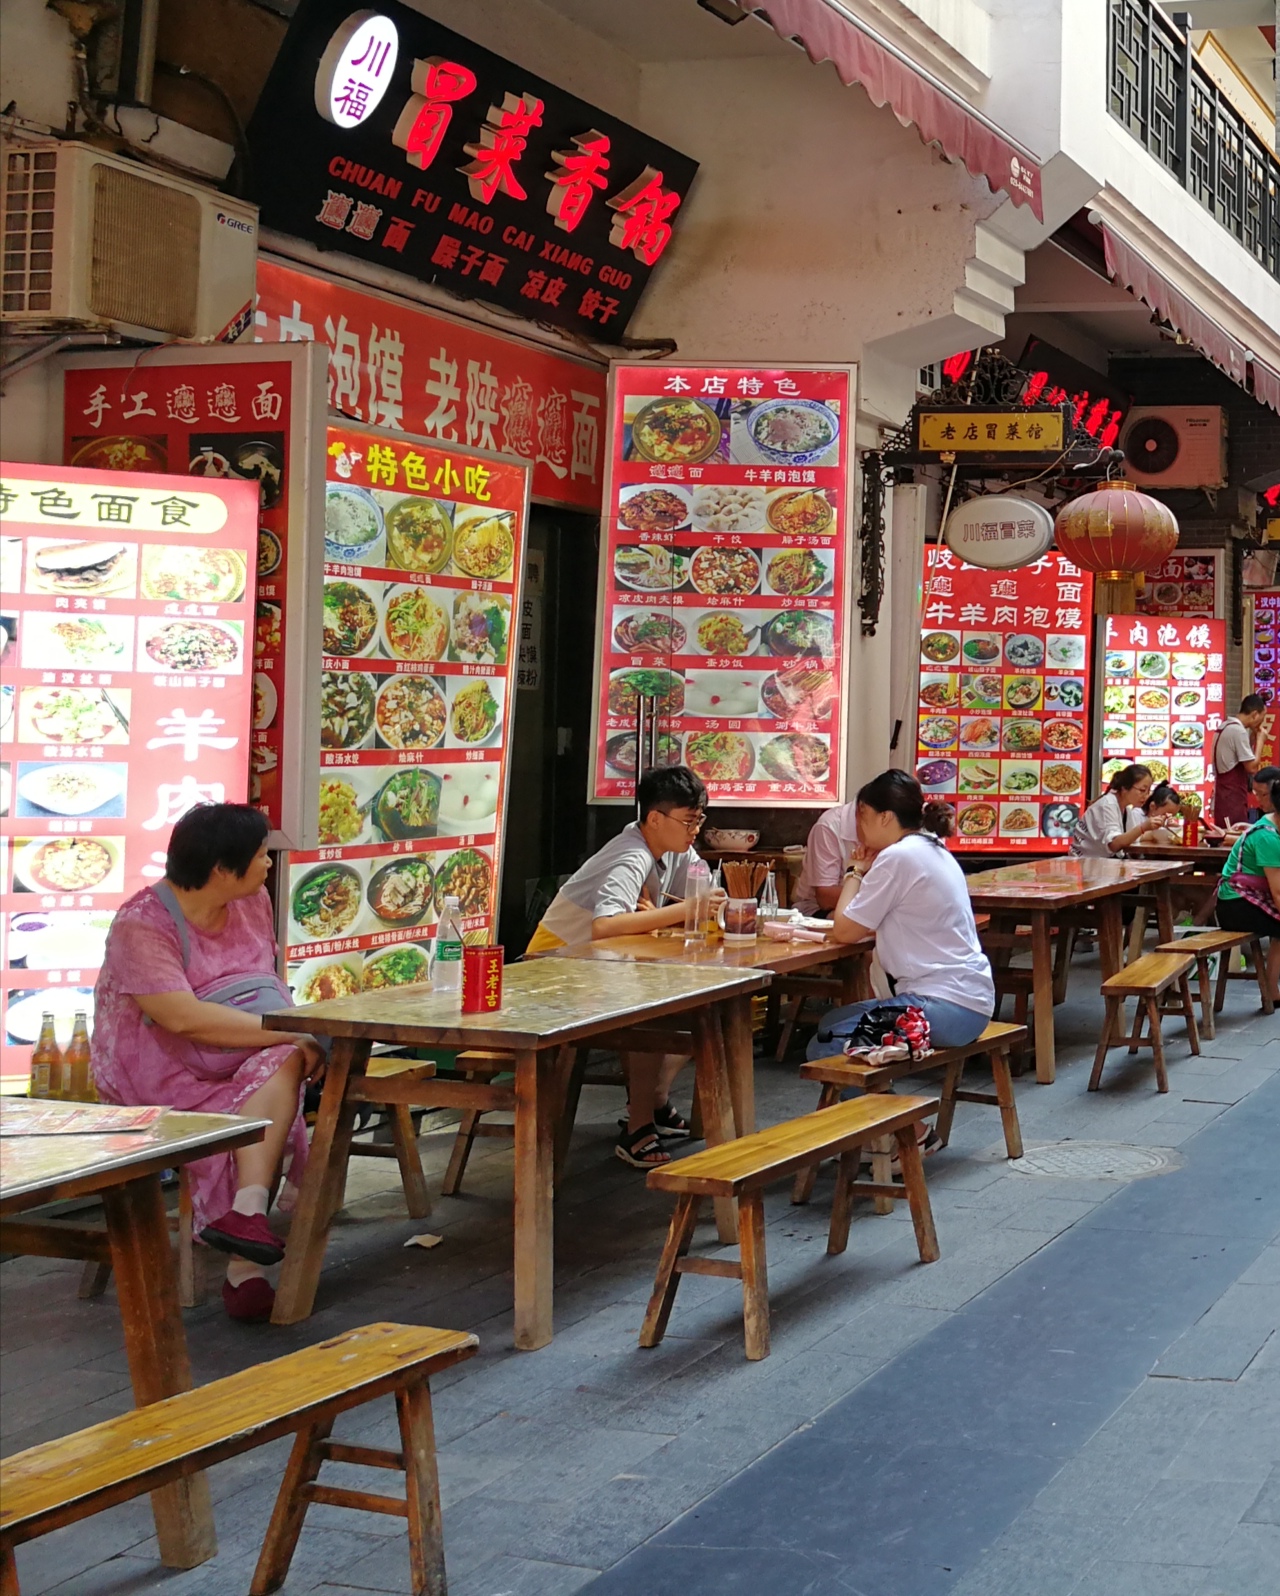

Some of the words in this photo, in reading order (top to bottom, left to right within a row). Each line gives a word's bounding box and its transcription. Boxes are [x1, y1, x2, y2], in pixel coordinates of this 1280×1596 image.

[334, 35, 391, 121] 川福
[400, 60, 681, 266] 冒菜香锅
[226, 217, 253, 235] GREE
[328, 155, 403, 200] CHUAN
[410, 188, 442, 214] FU
[447, 201, 495, 235] MAO
[502, 225, 536, 251] CAI
[538, 243, 595, 275] XIANG
[598, 264, 633, 291] GUO
[520, 268, 568, 308] 凉皮
[578, 287, 622, 325] 饺子
[663, 376, 801, 396] 本店特色
[940, 421, 1044, 441] 老店冒菜馆
[366, 443, 492, 502] 特色小吃
[744, 469, 816, 484] 牛羊肉泡馍
[638, 532, 676, 543] 香辣虾
[713, 533, 742, 545] 干饺
[962, 519, 1036, 543] 川福冒菜
[926, 601, 1083, 629] 牛羊肉泡馍
[631, 656, 667, 667] 冒菜
[706, 658, 744, 669] 蛋炒饭
[705, 720, 741, 731] 汤圆
[325, 752, 359, 765] 酸汤水饺
[768, 783, 827, 793] 重庆小面
[318, 848, 343, 860] 蛋炒饭
[485, 959, 499, 1008] 王老吉
